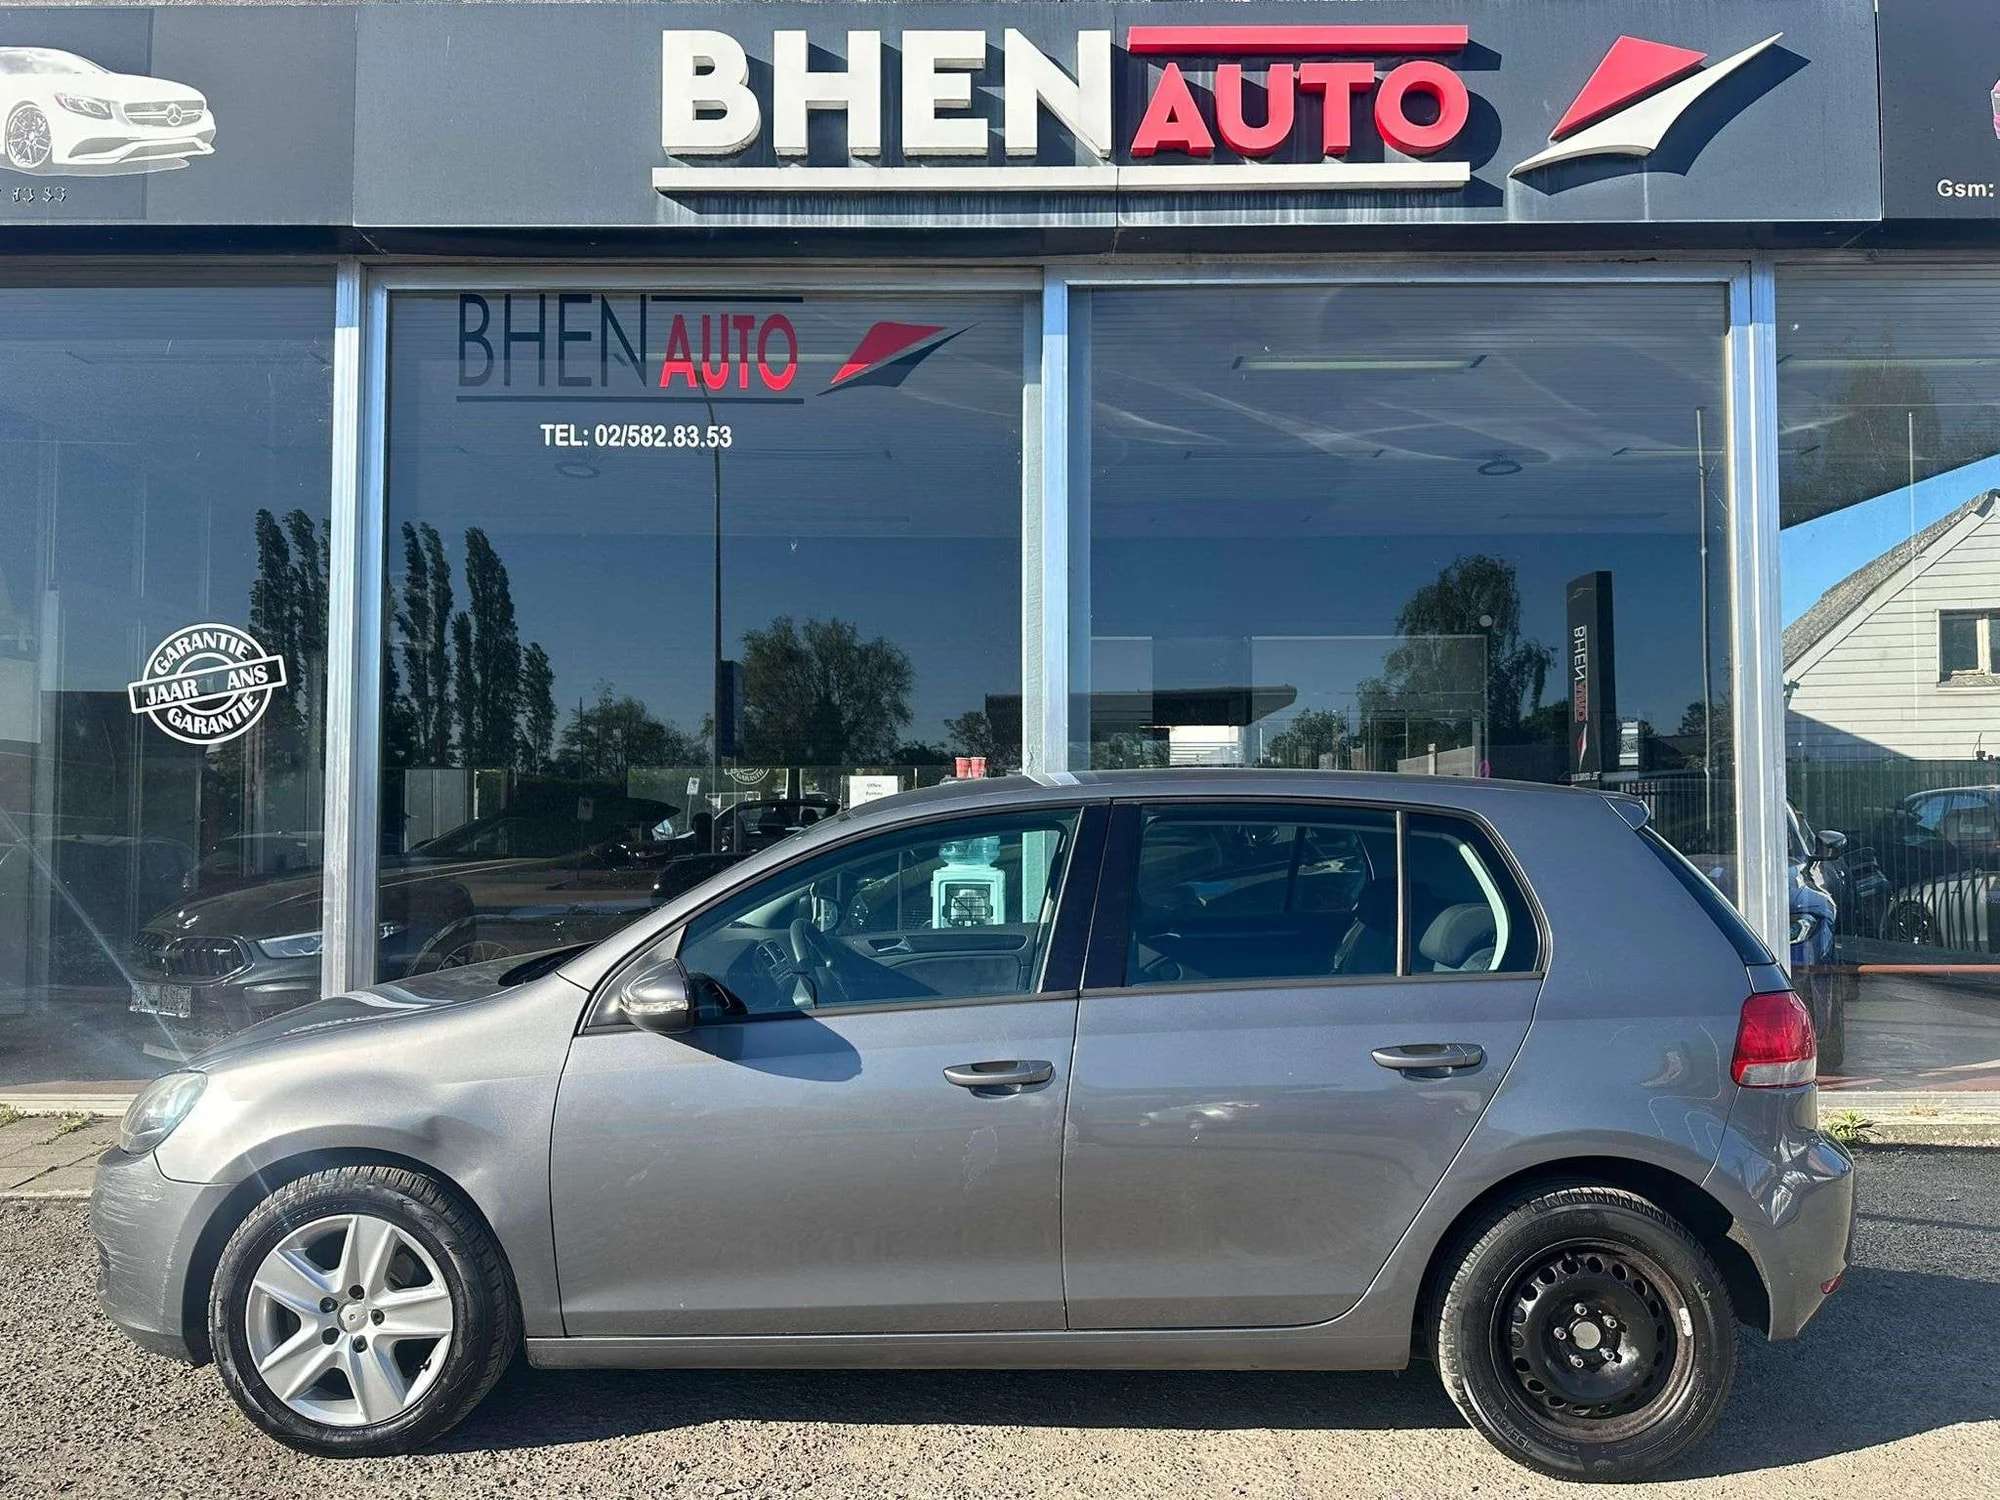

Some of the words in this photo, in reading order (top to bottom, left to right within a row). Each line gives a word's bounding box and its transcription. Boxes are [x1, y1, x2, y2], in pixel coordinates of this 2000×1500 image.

[662, 29, 1111, 158] BHEN
[1130, 60, 1470, 157] AUTO
[1937, 179, 1994, 198] Gsm:
[458, 294, 647, 387] BHEN
[659, 313, 798, 392] AUTO
[540, 424, 589, 447] TEL:
[594, 424, 733, 448] 02/582.83.53
[154, 631, 252, 675] GARANTIE
[146, 678, 200, 706] JAAR
[227, 664, 269, 691] ANS
[167, 693, 259, 735] GARANTIE
